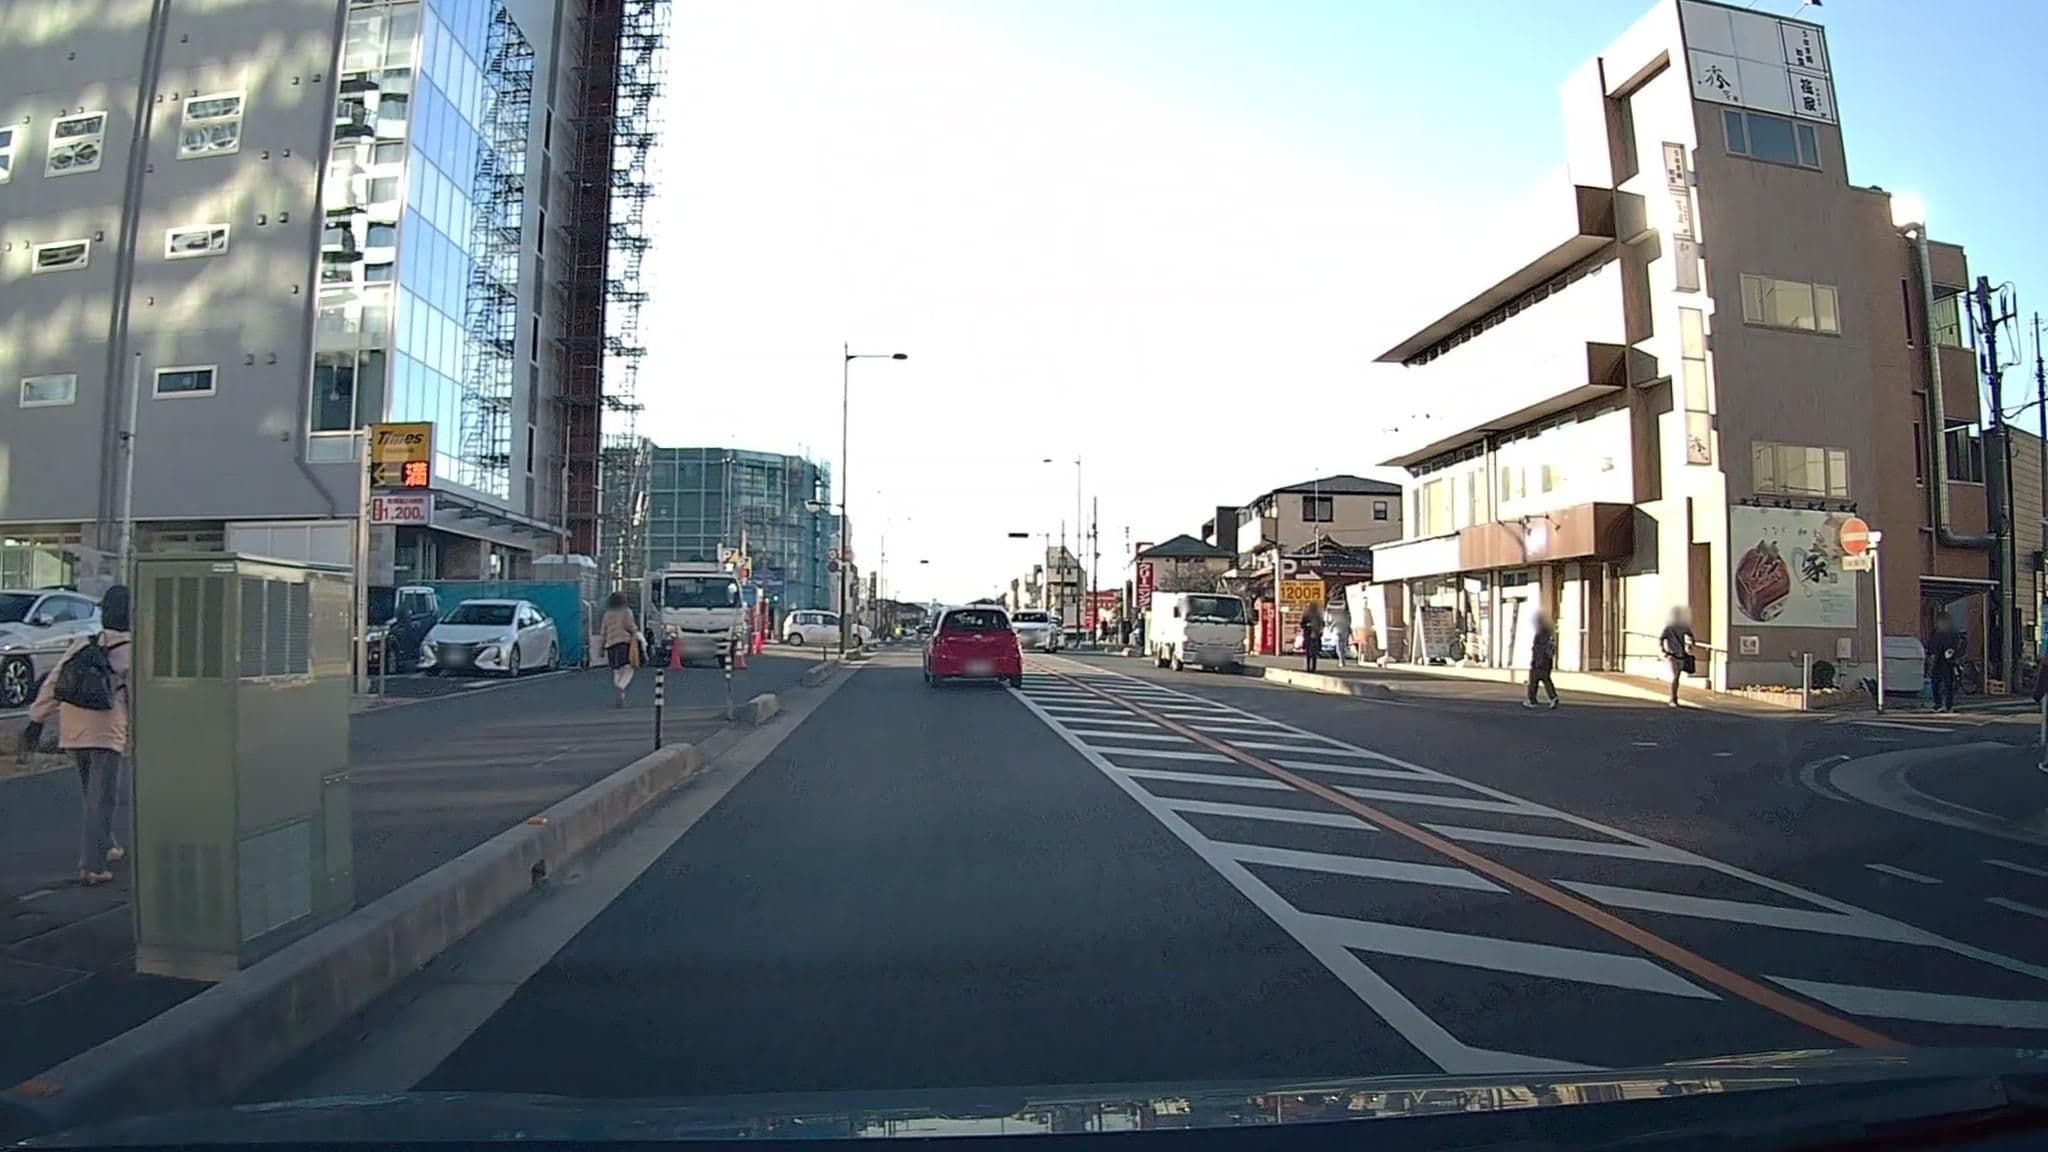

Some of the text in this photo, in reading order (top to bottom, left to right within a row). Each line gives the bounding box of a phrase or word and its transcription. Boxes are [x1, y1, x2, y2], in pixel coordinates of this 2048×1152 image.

[378, 431, 424, 445] Times
[405, 462, 428, 486] 満
[1281, 560, 1297, 579] P
[1281, 586, 1321, 600] 1200円
